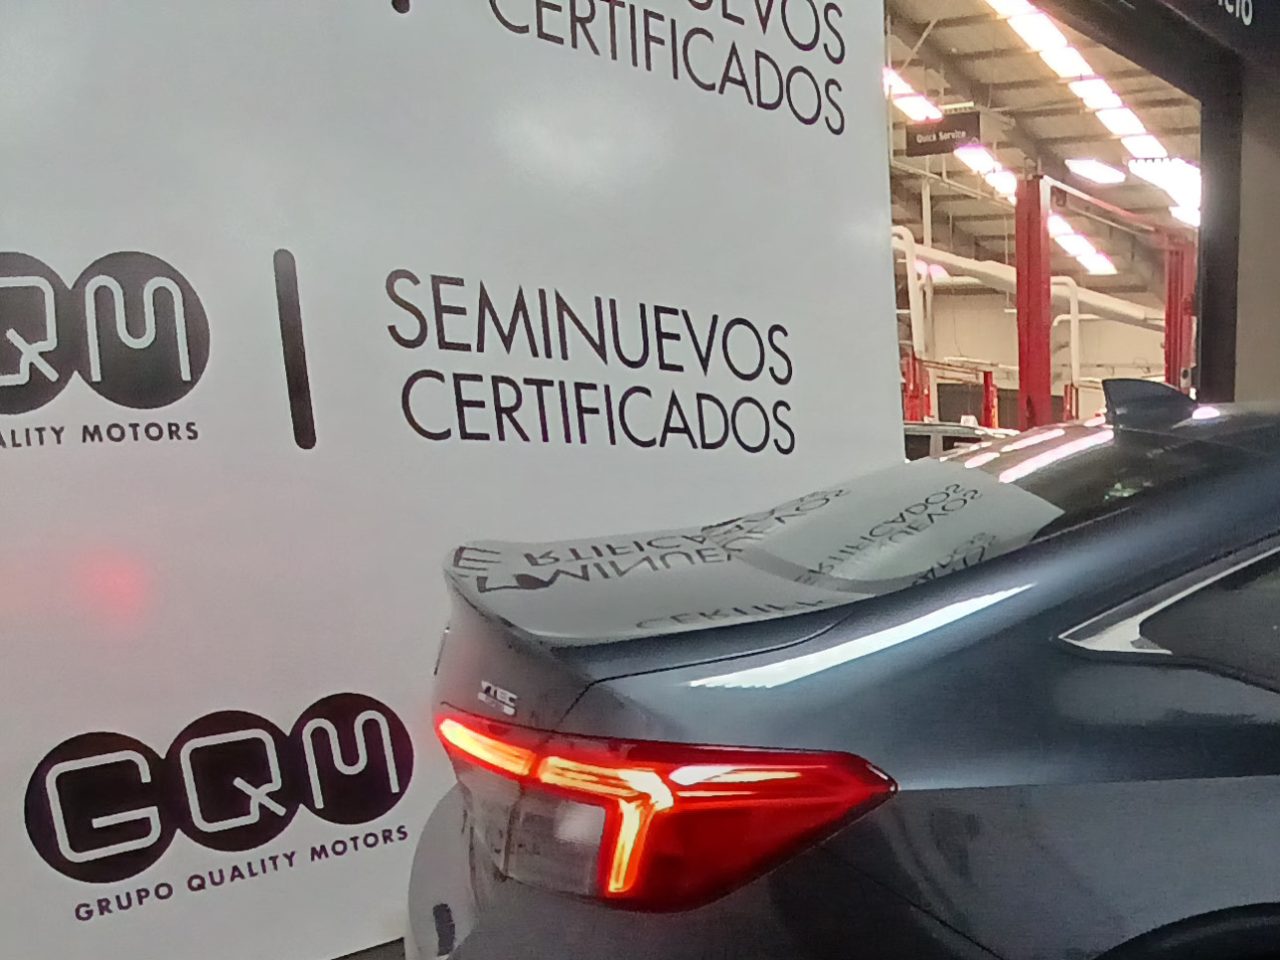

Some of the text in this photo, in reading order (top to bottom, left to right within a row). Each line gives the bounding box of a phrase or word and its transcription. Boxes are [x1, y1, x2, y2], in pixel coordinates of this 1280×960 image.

[385, 268, 793, 385] SEMINUEVOS
[81, 421, 199, 444] MOTORS
[401, 368, 796, 455] CERTIFICADOS
[45, 709, 400, 864] GQM
[74, 825, 409, 921] GRUPO QUALITY MOTORS
